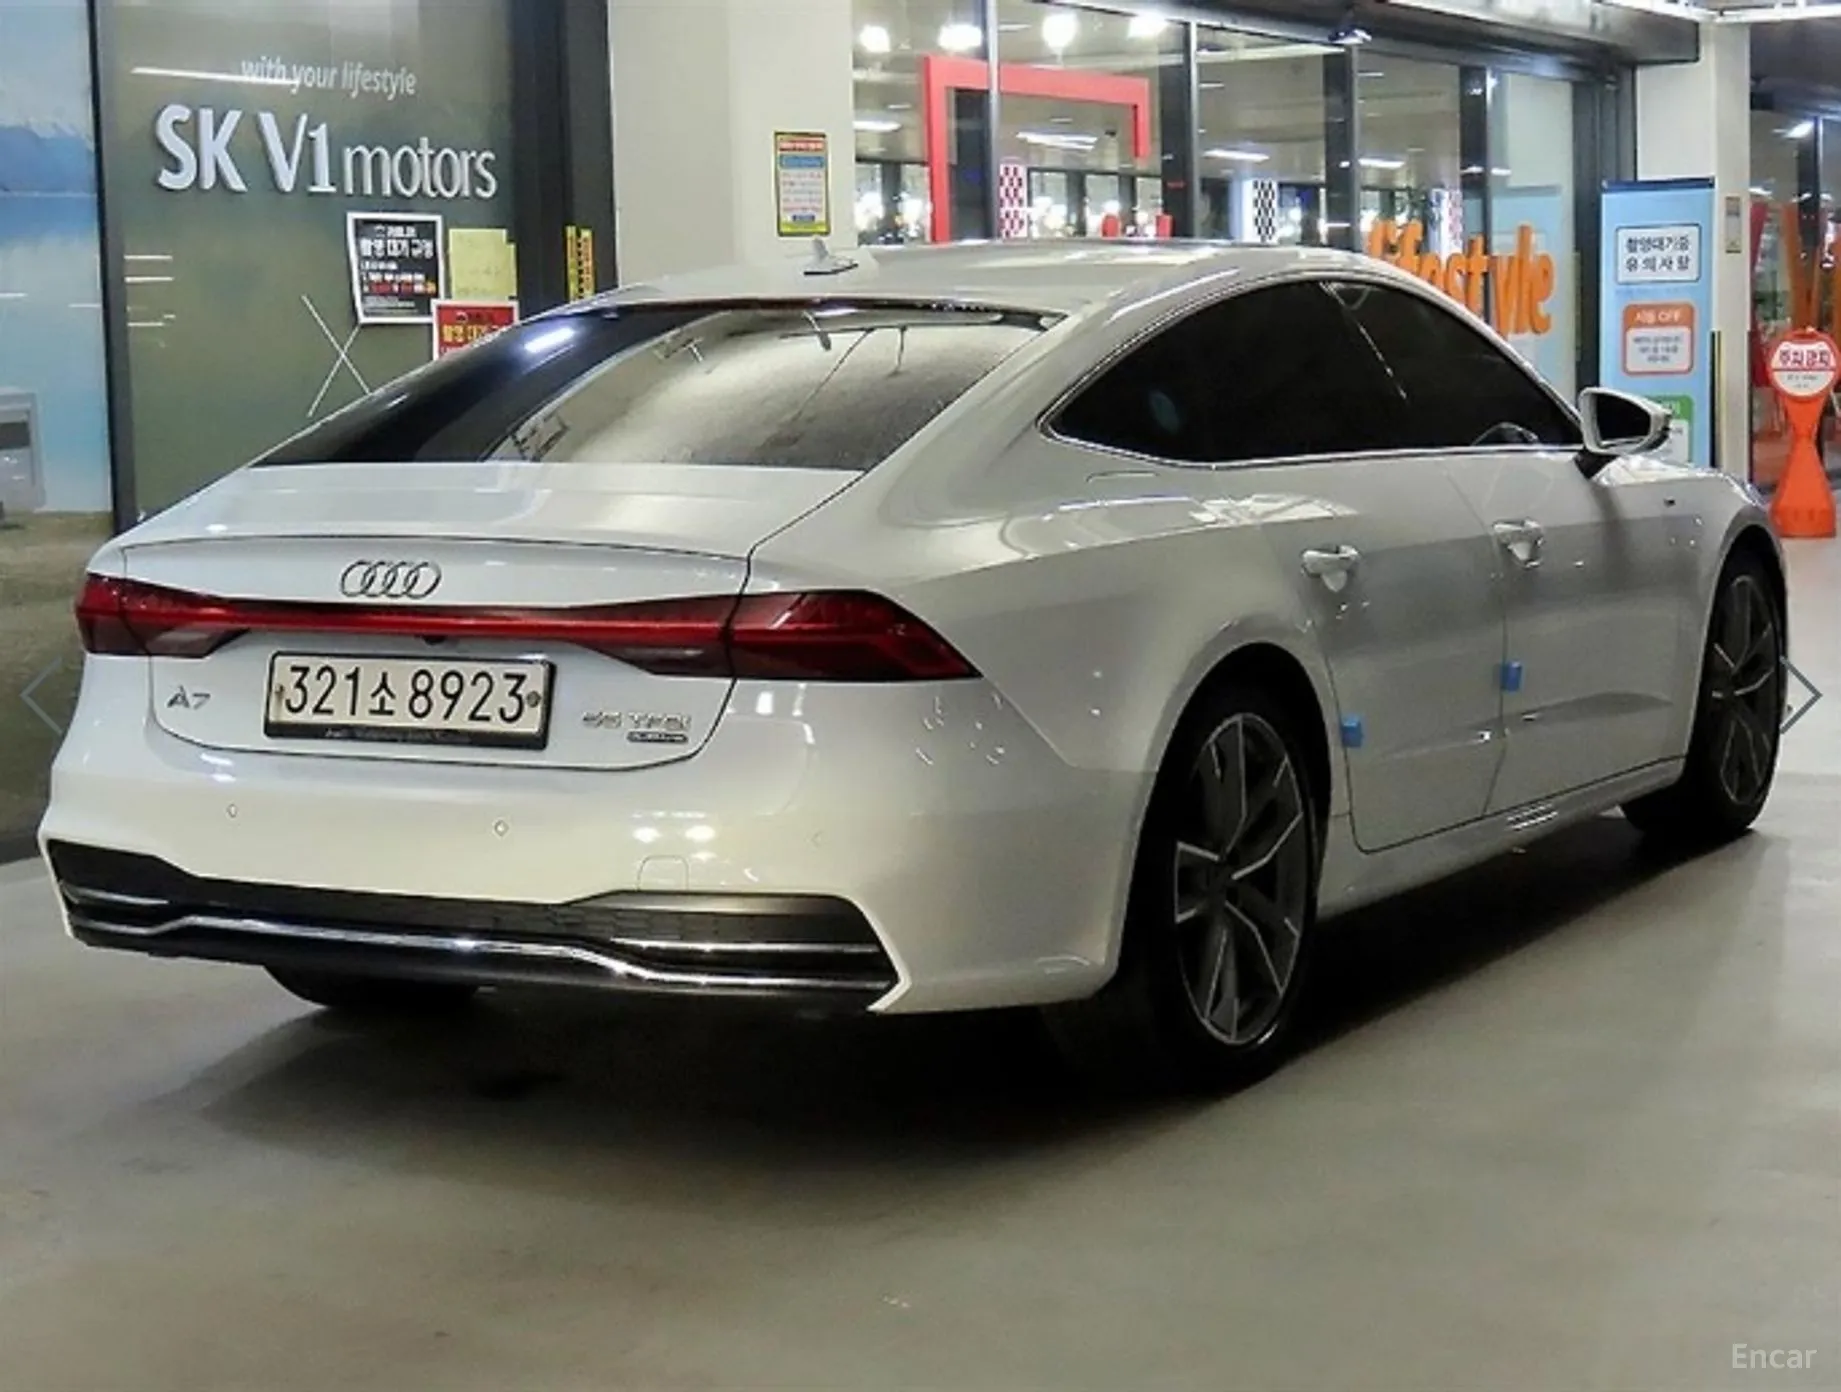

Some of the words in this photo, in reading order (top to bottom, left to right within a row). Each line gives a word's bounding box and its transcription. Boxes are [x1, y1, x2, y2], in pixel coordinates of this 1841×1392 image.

[241, 56, 287, 84] with
[290, 65, 337, 94] your
[341, 61, 417, 100] lifestyle
[156, 104, 248, 192] SK
[259, 111, 337, 193] V1
[345, 136, 497, 199] motors
[167, 685, 211, 710] A7
